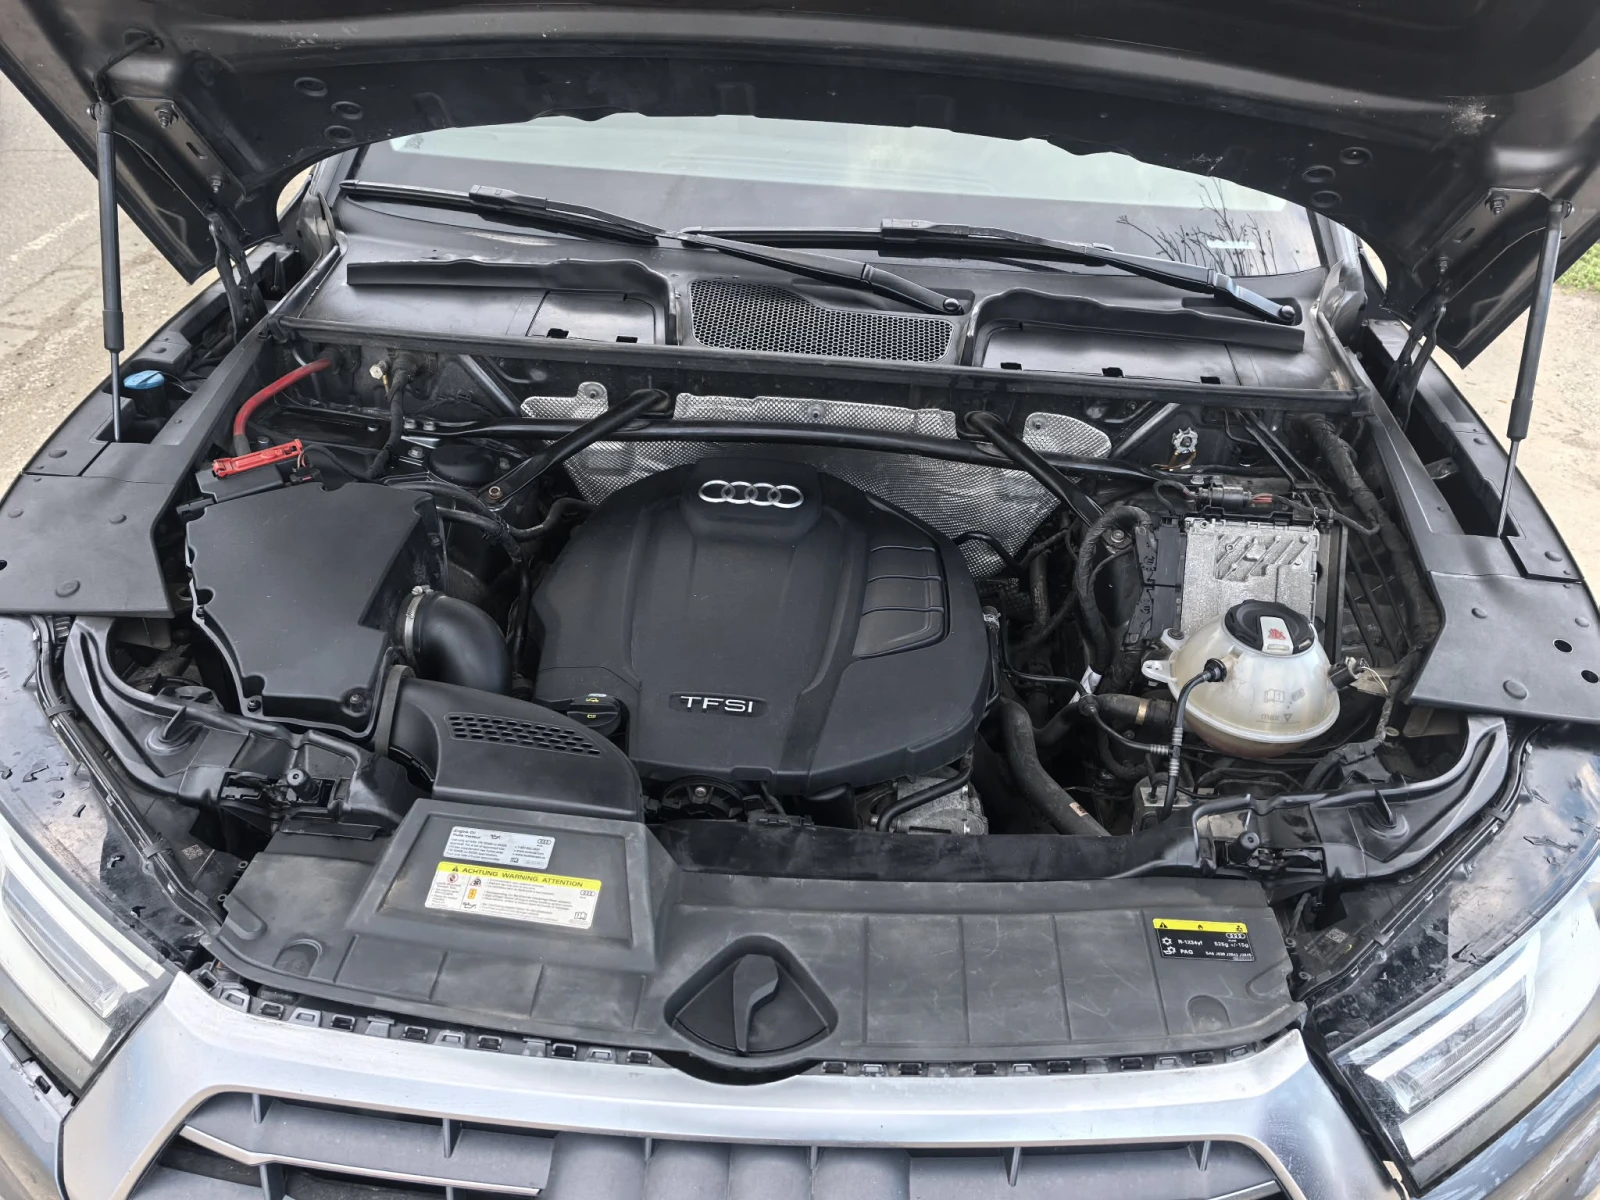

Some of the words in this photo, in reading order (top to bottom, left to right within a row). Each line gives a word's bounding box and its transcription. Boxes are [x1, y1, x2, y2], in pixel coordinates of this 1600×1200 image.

[680, 695, 753, 713] TFSI
[1261, 713, 1279, 721] max
[462, 867, 498, 877] ACHTUNG
[502, 872, 539, 882] WARNING
[542, 877, 584, 888] ATTENTION
